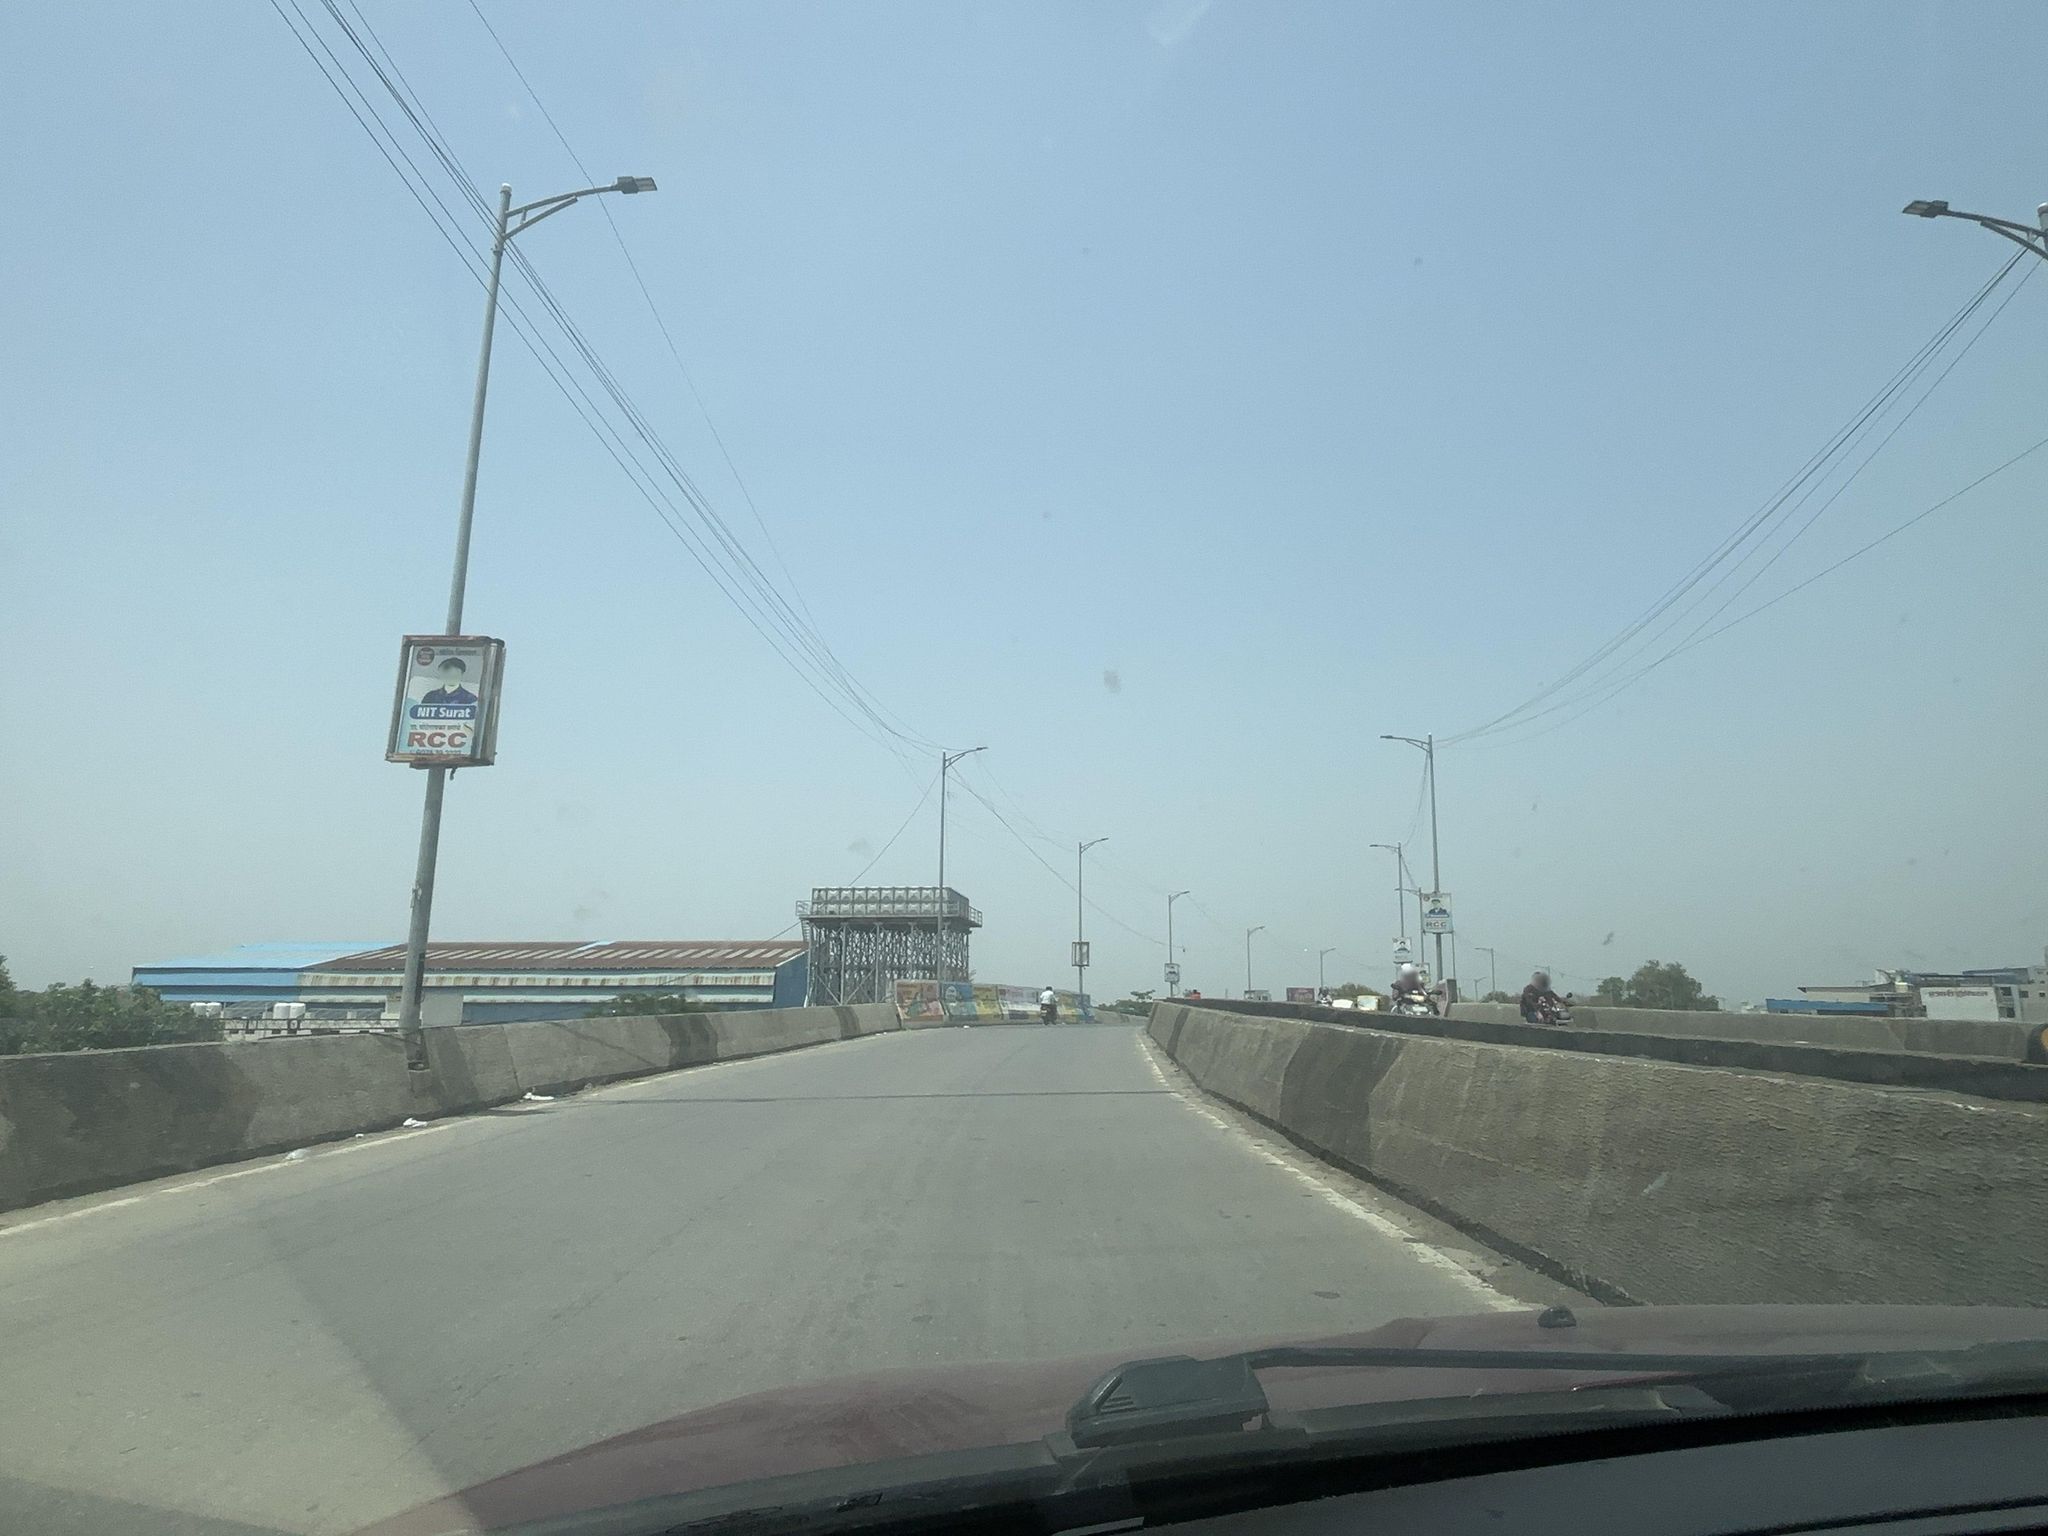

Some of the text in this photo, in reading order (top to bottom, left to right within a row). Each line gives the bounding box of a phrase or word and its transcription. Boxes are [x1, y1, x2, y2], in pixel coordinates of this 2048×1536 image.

[417, 707, 471, 717] NIT Surat
[407, 732, 467, 747] RCC
